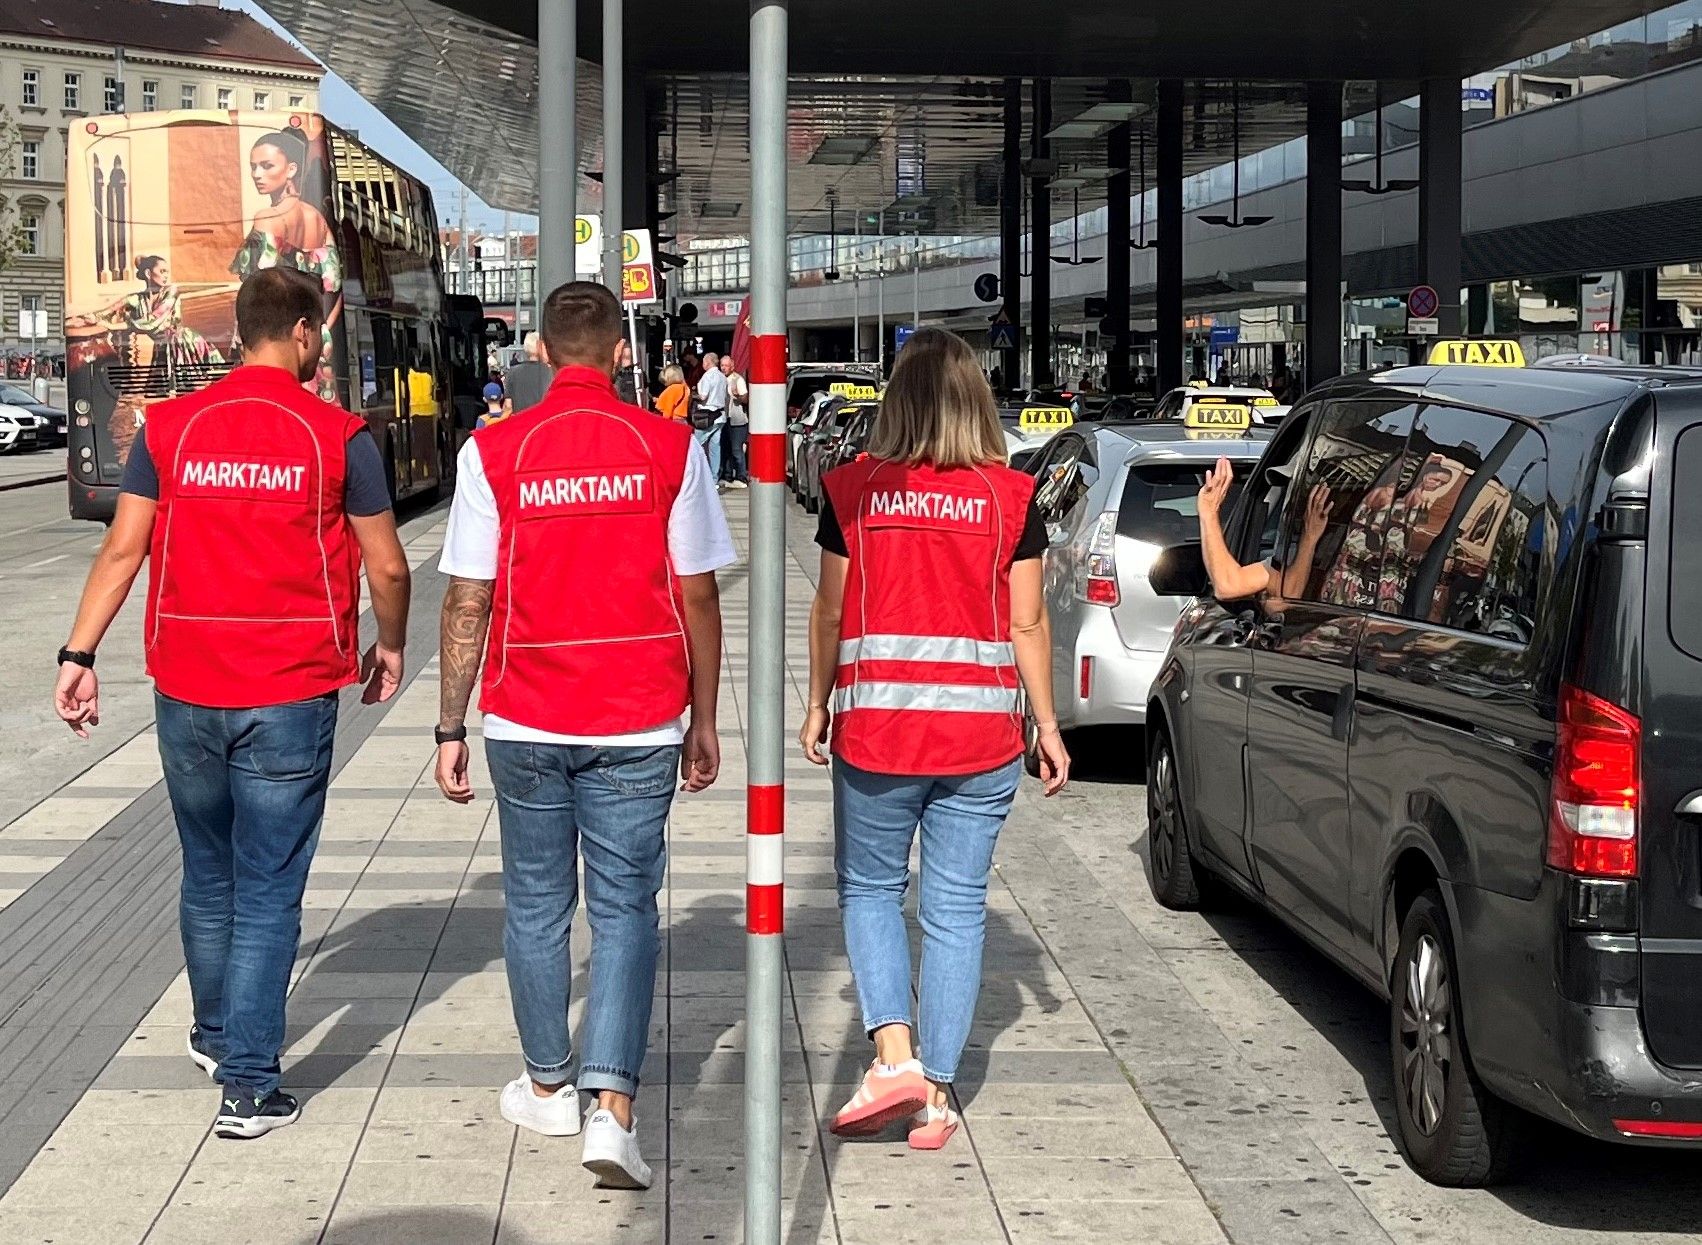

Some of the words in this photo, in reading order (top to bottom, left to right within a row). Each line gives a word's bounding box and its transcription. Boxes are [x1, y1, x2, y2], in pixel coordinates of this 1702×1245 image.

[1449, 343, 1513, 363] TAXI
[1028, 411, 1066, 423] TAXI
[1199, 409, 1241, 423] TAXI
[182, 460, 305, 492] MARKTAMT
[519, 474, 646, 509] MARKTAMT
[870, 490, 987, 523] MARKTAMT
